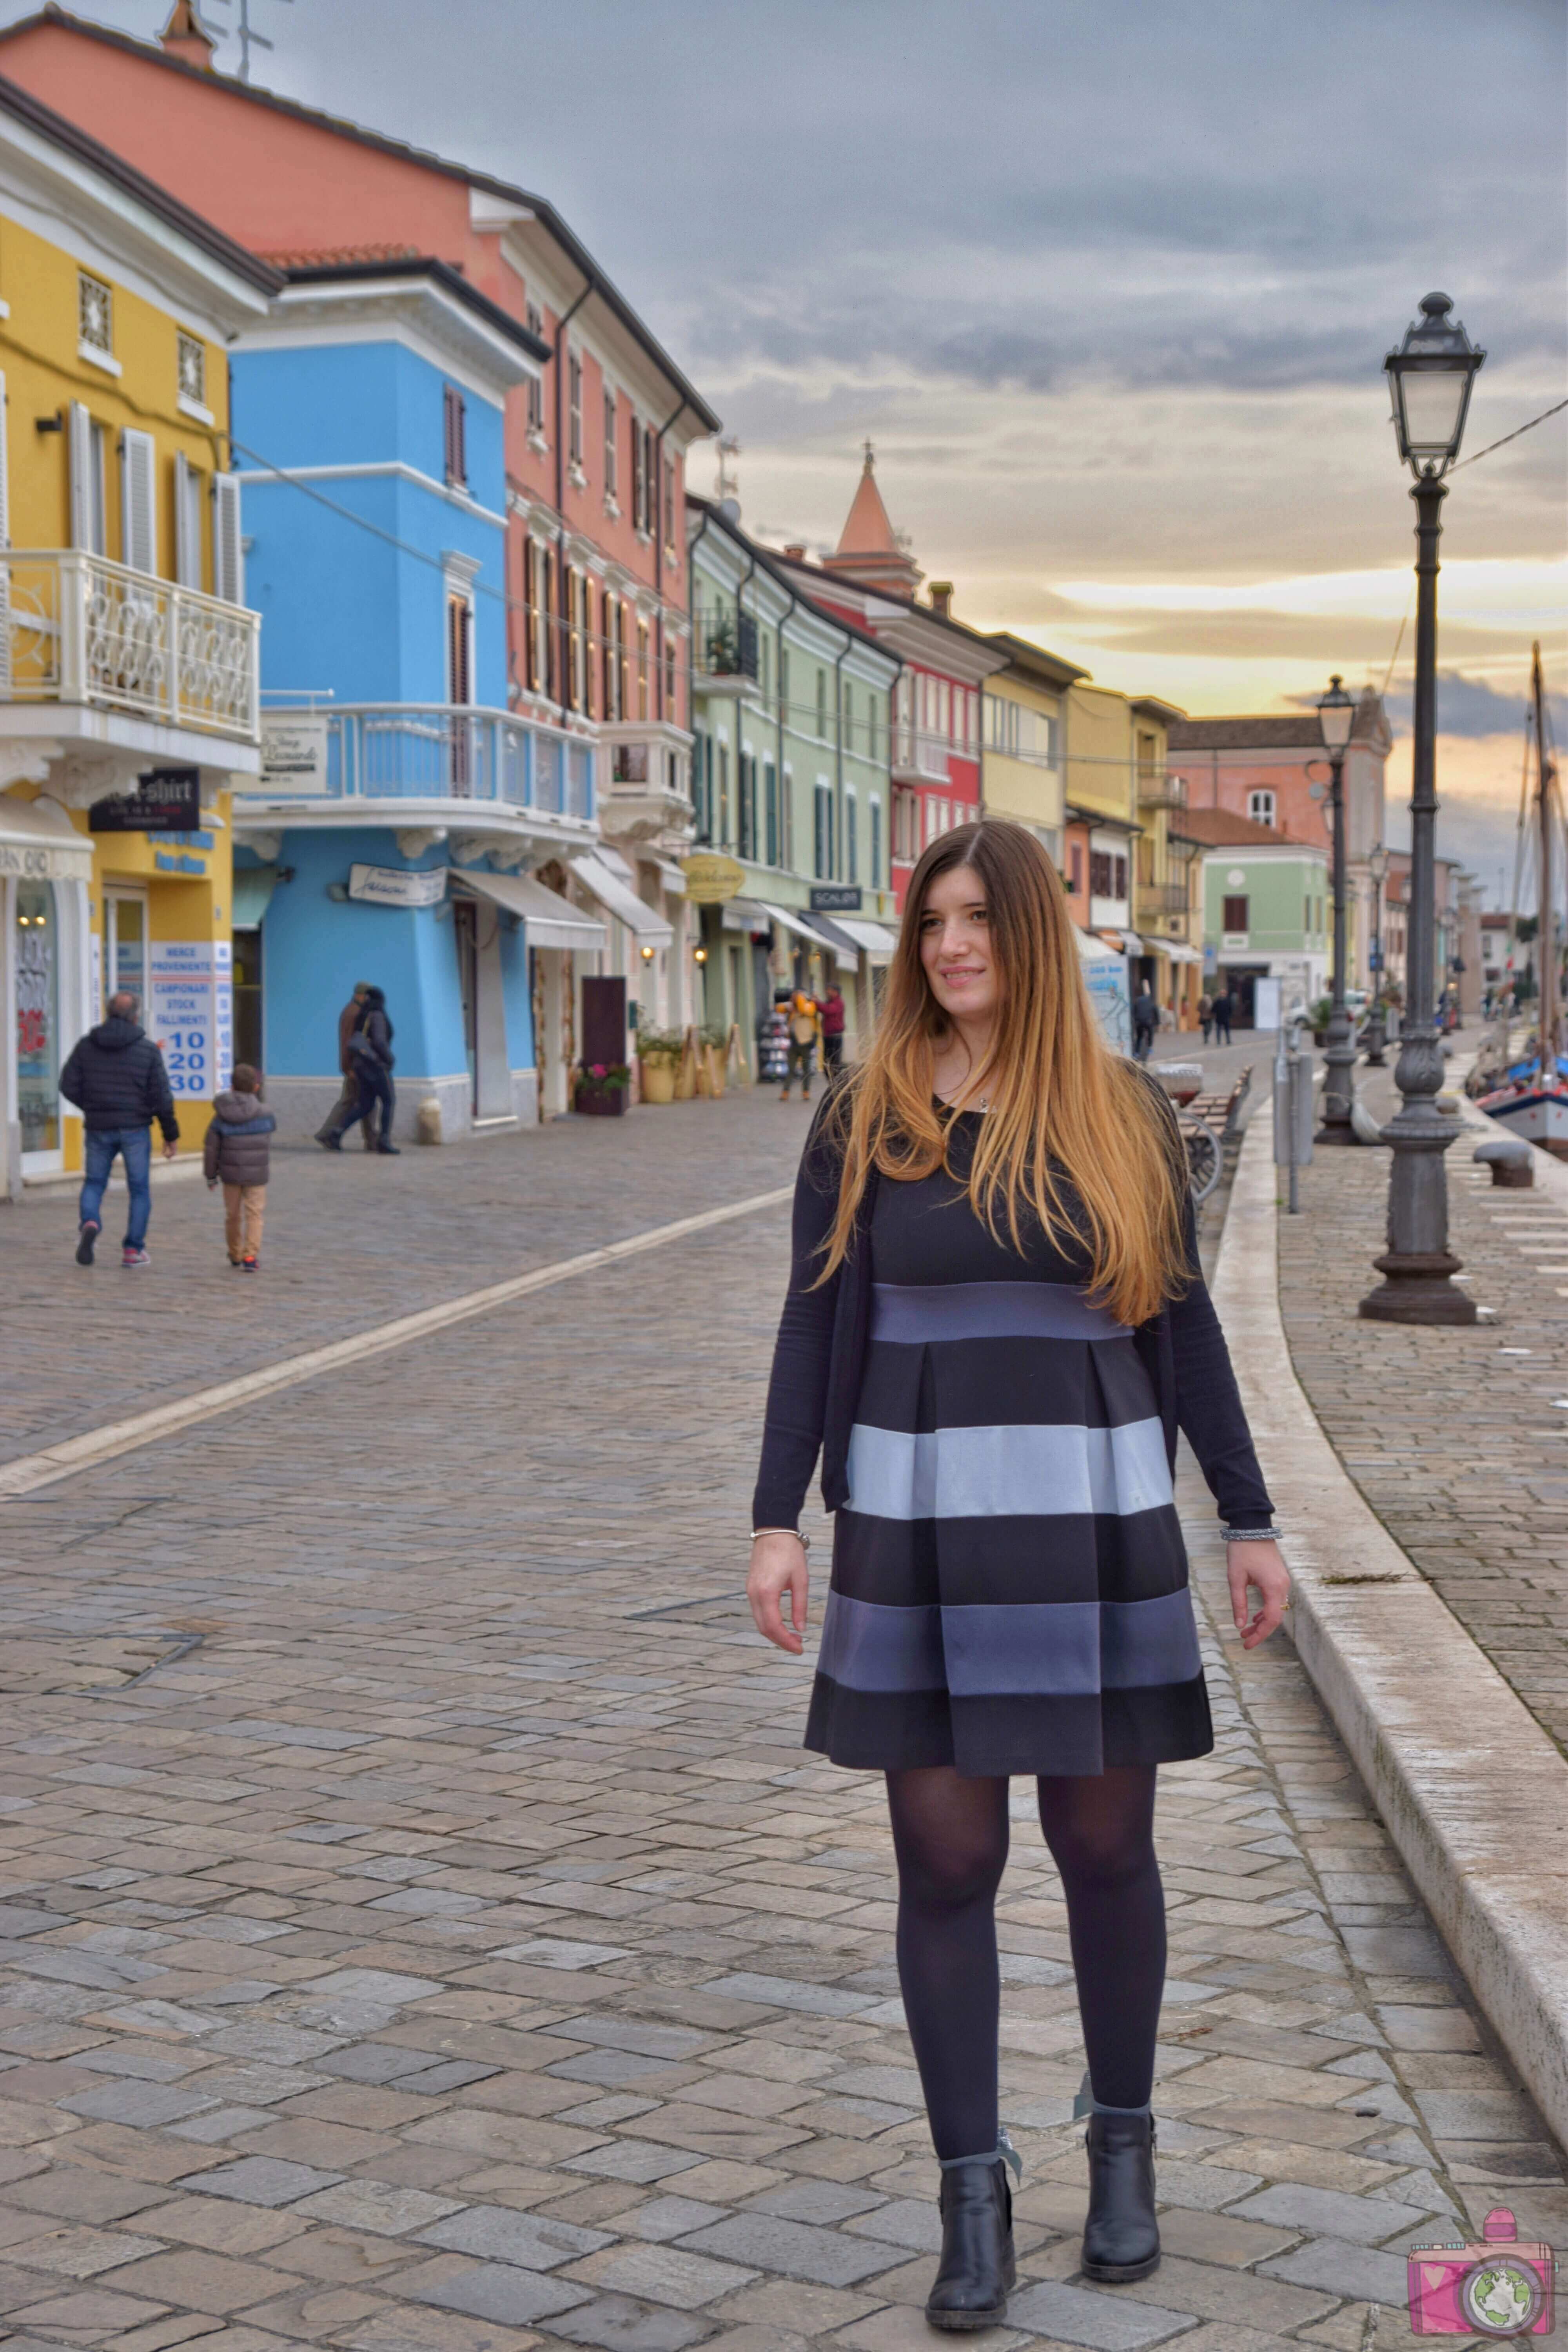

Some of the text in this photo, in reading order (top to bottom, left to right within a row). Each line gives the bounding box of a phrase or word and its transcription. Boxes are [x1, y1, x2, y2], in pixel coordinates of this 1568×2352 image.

[167, 947, 195, 957] MERCE
[152, 962, 211, 971] PROVENIENTE
[167, 1000, 195, 1009] STOCK
[169, 1031, 204, 1049] 10
[169, 1053, 204, 1070] 20
[170, 1074, 205, 1091] 30
